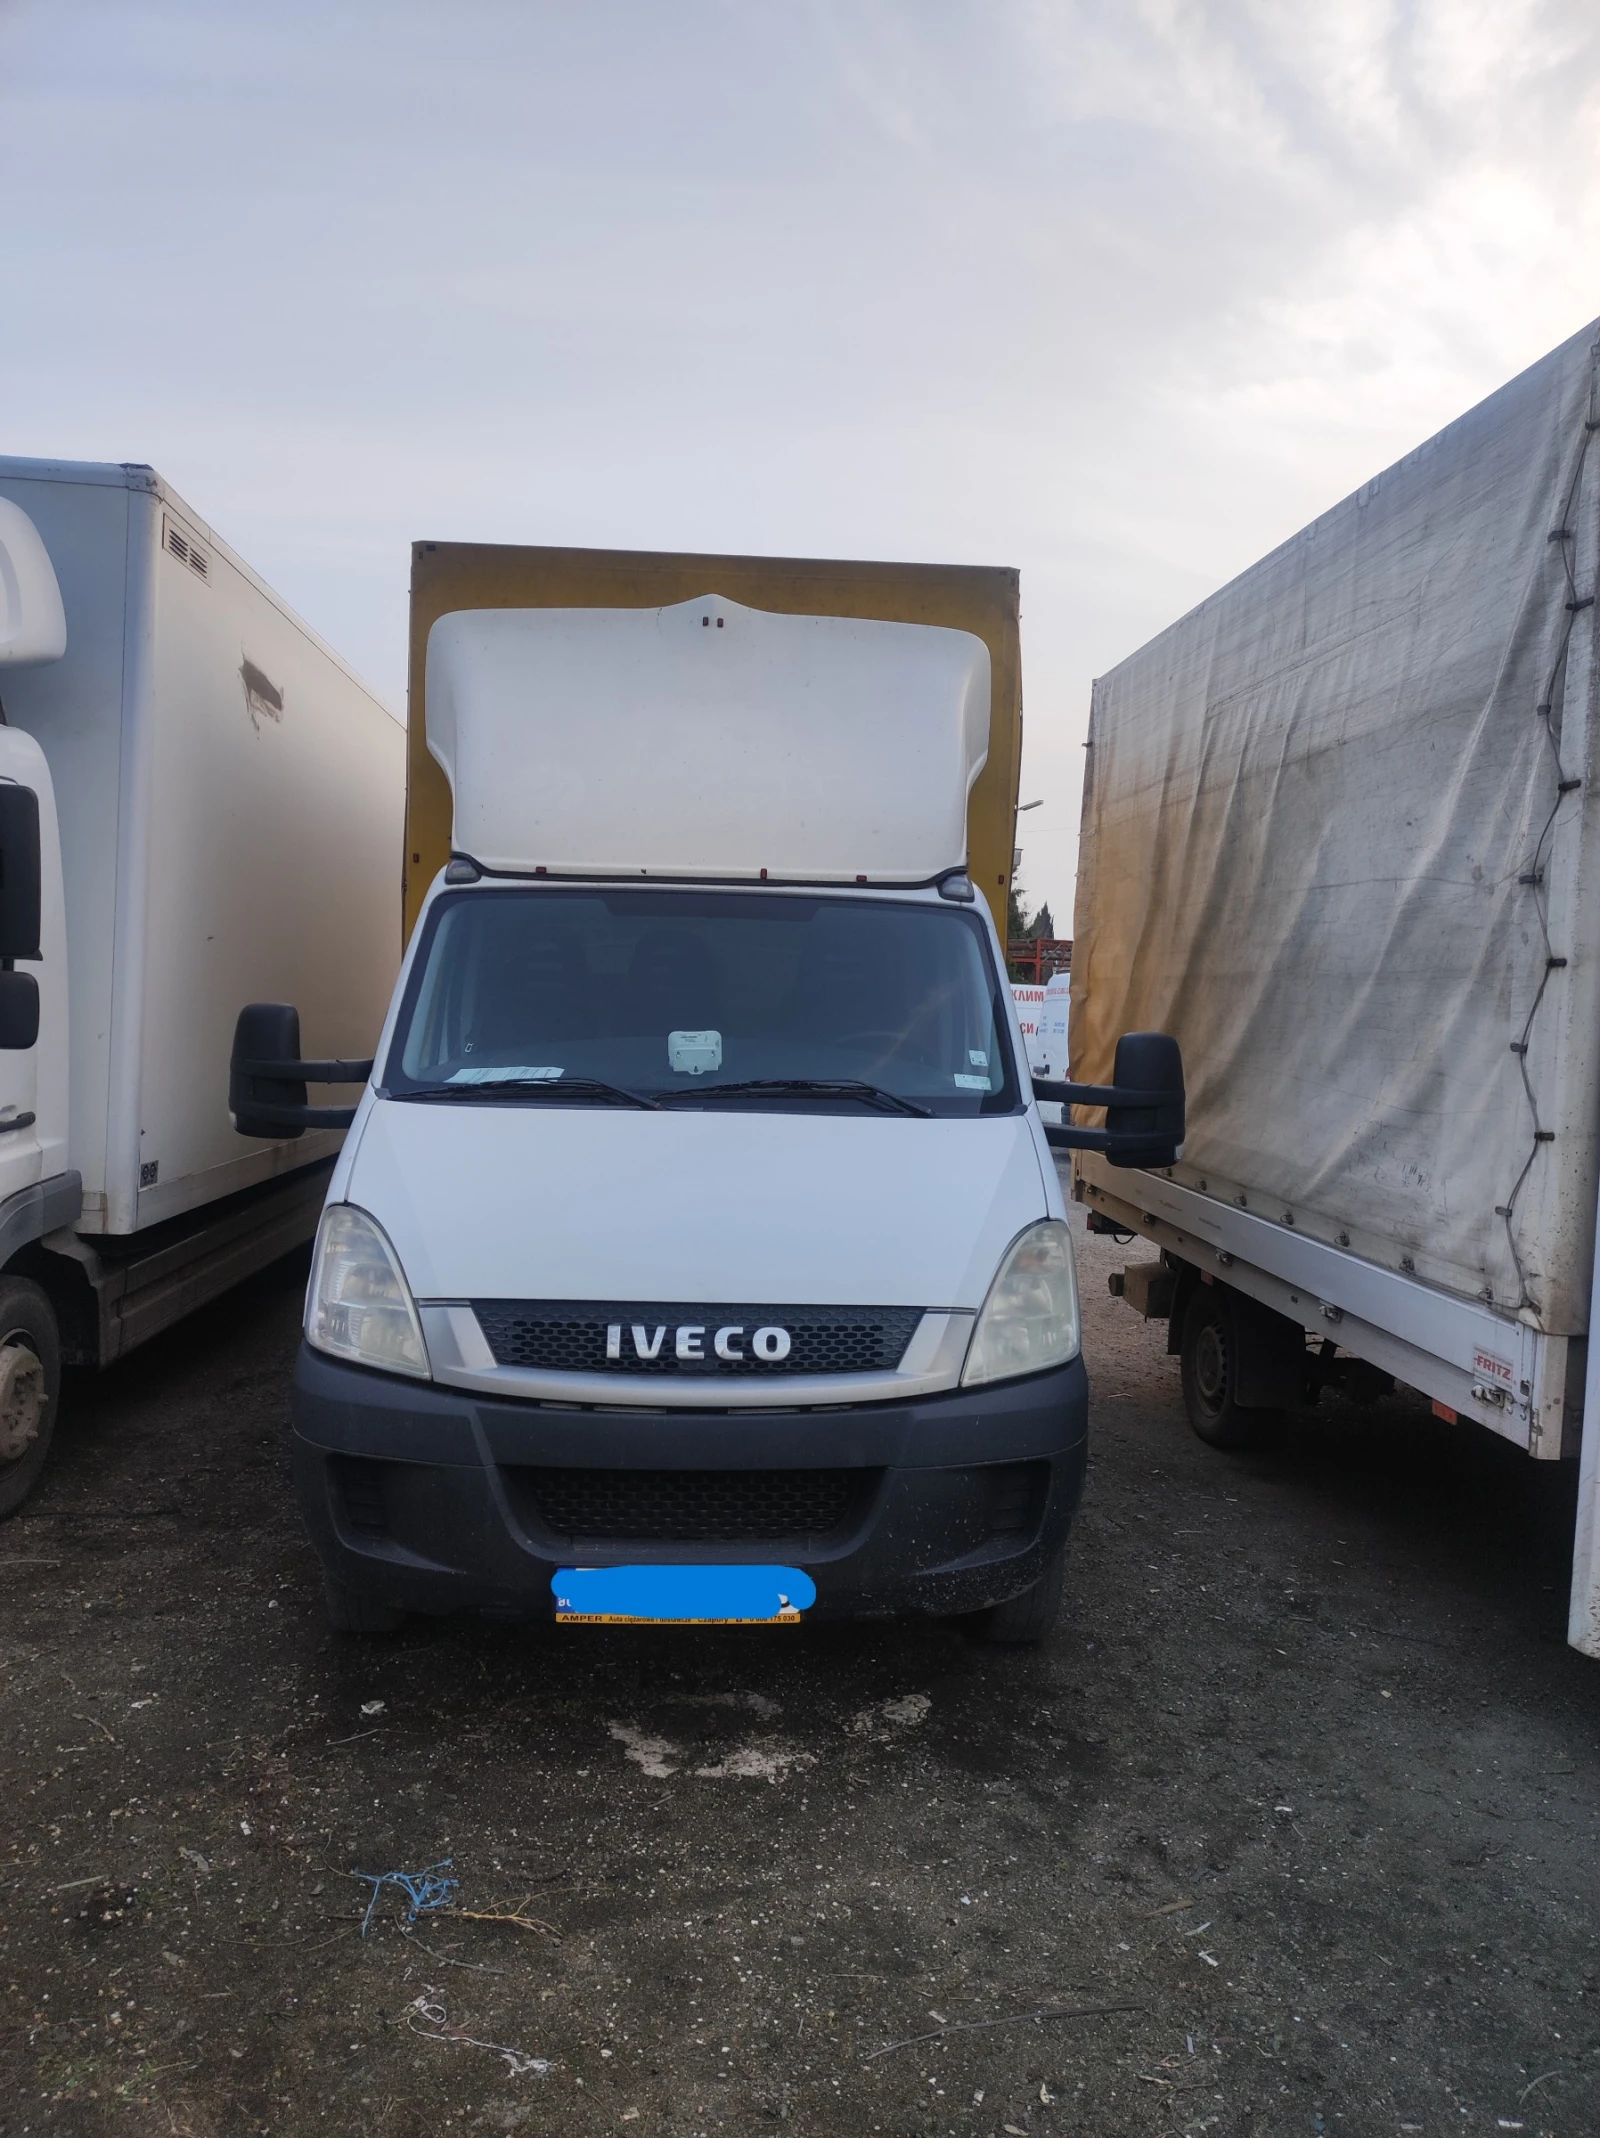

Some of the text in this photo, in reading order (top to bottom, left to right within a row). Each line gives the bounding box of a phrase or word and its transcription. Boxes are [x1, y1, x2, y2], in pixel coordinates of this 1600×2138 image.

[606, 1324, 791, 1362] IVECO
[1474, 1354, 1511, 1381] FRITZ
[562, 1614, 603, 1622] AMPER
